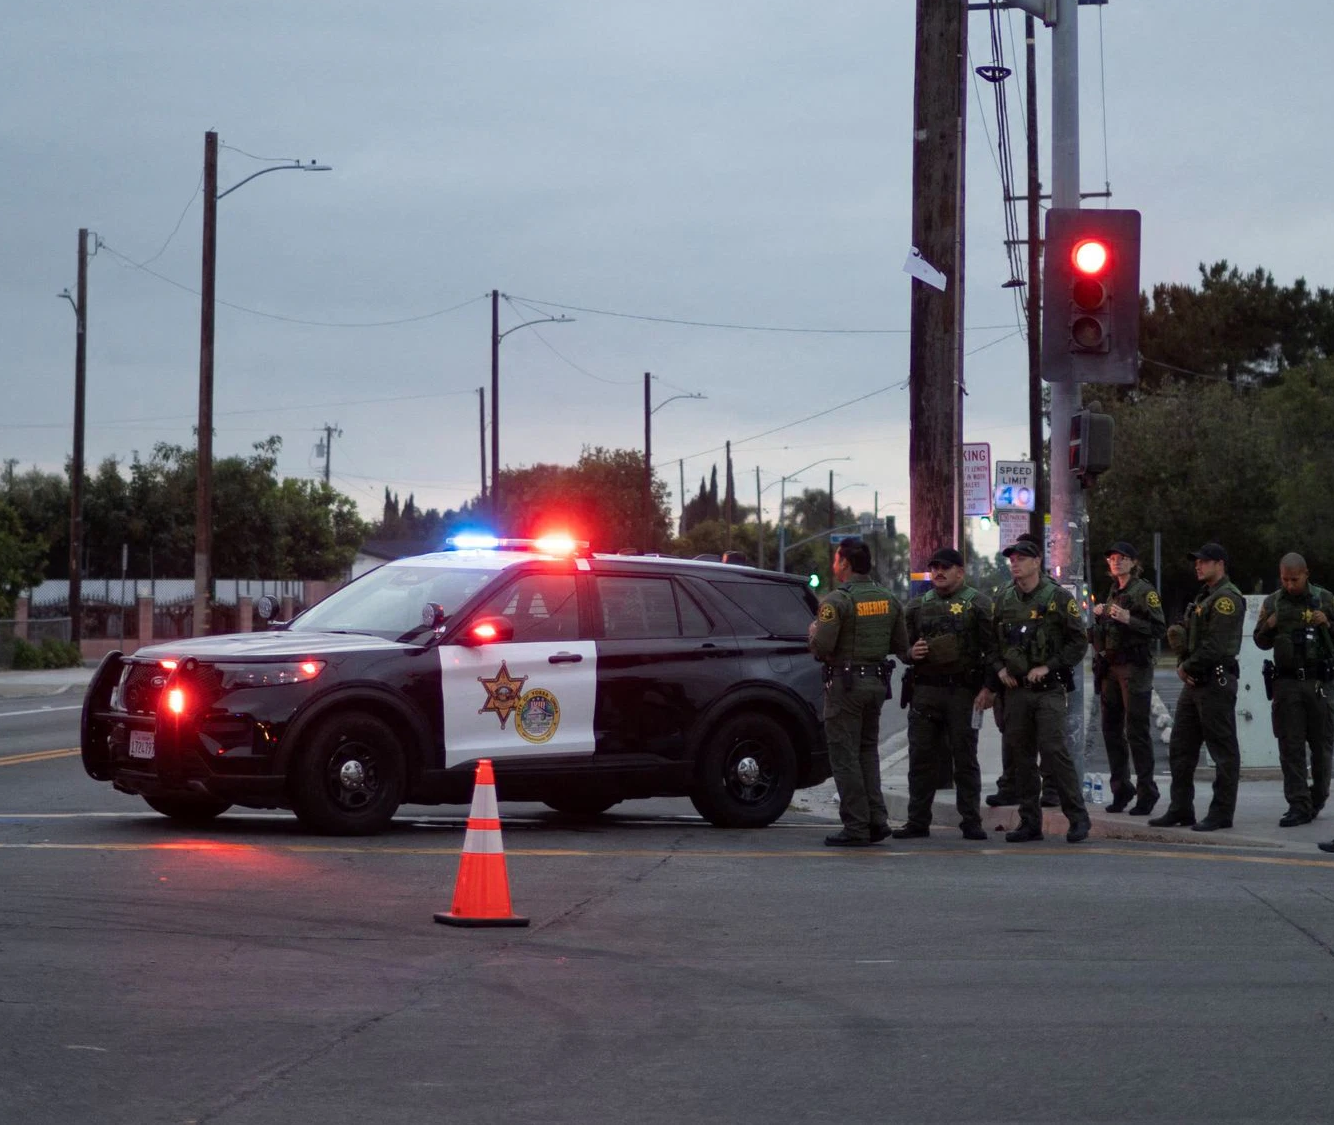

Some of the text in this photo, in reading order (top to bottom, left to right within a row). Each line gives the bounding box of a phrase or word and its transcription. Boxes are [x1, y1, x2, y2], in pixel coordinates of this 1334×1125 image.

[999, 466, 1032, 475] SPEED
[1002, 477, 1028, 485] LIMIT
[998, 486, 1032, 507] 40
[856, 600, 889, 617] SHERIFF
